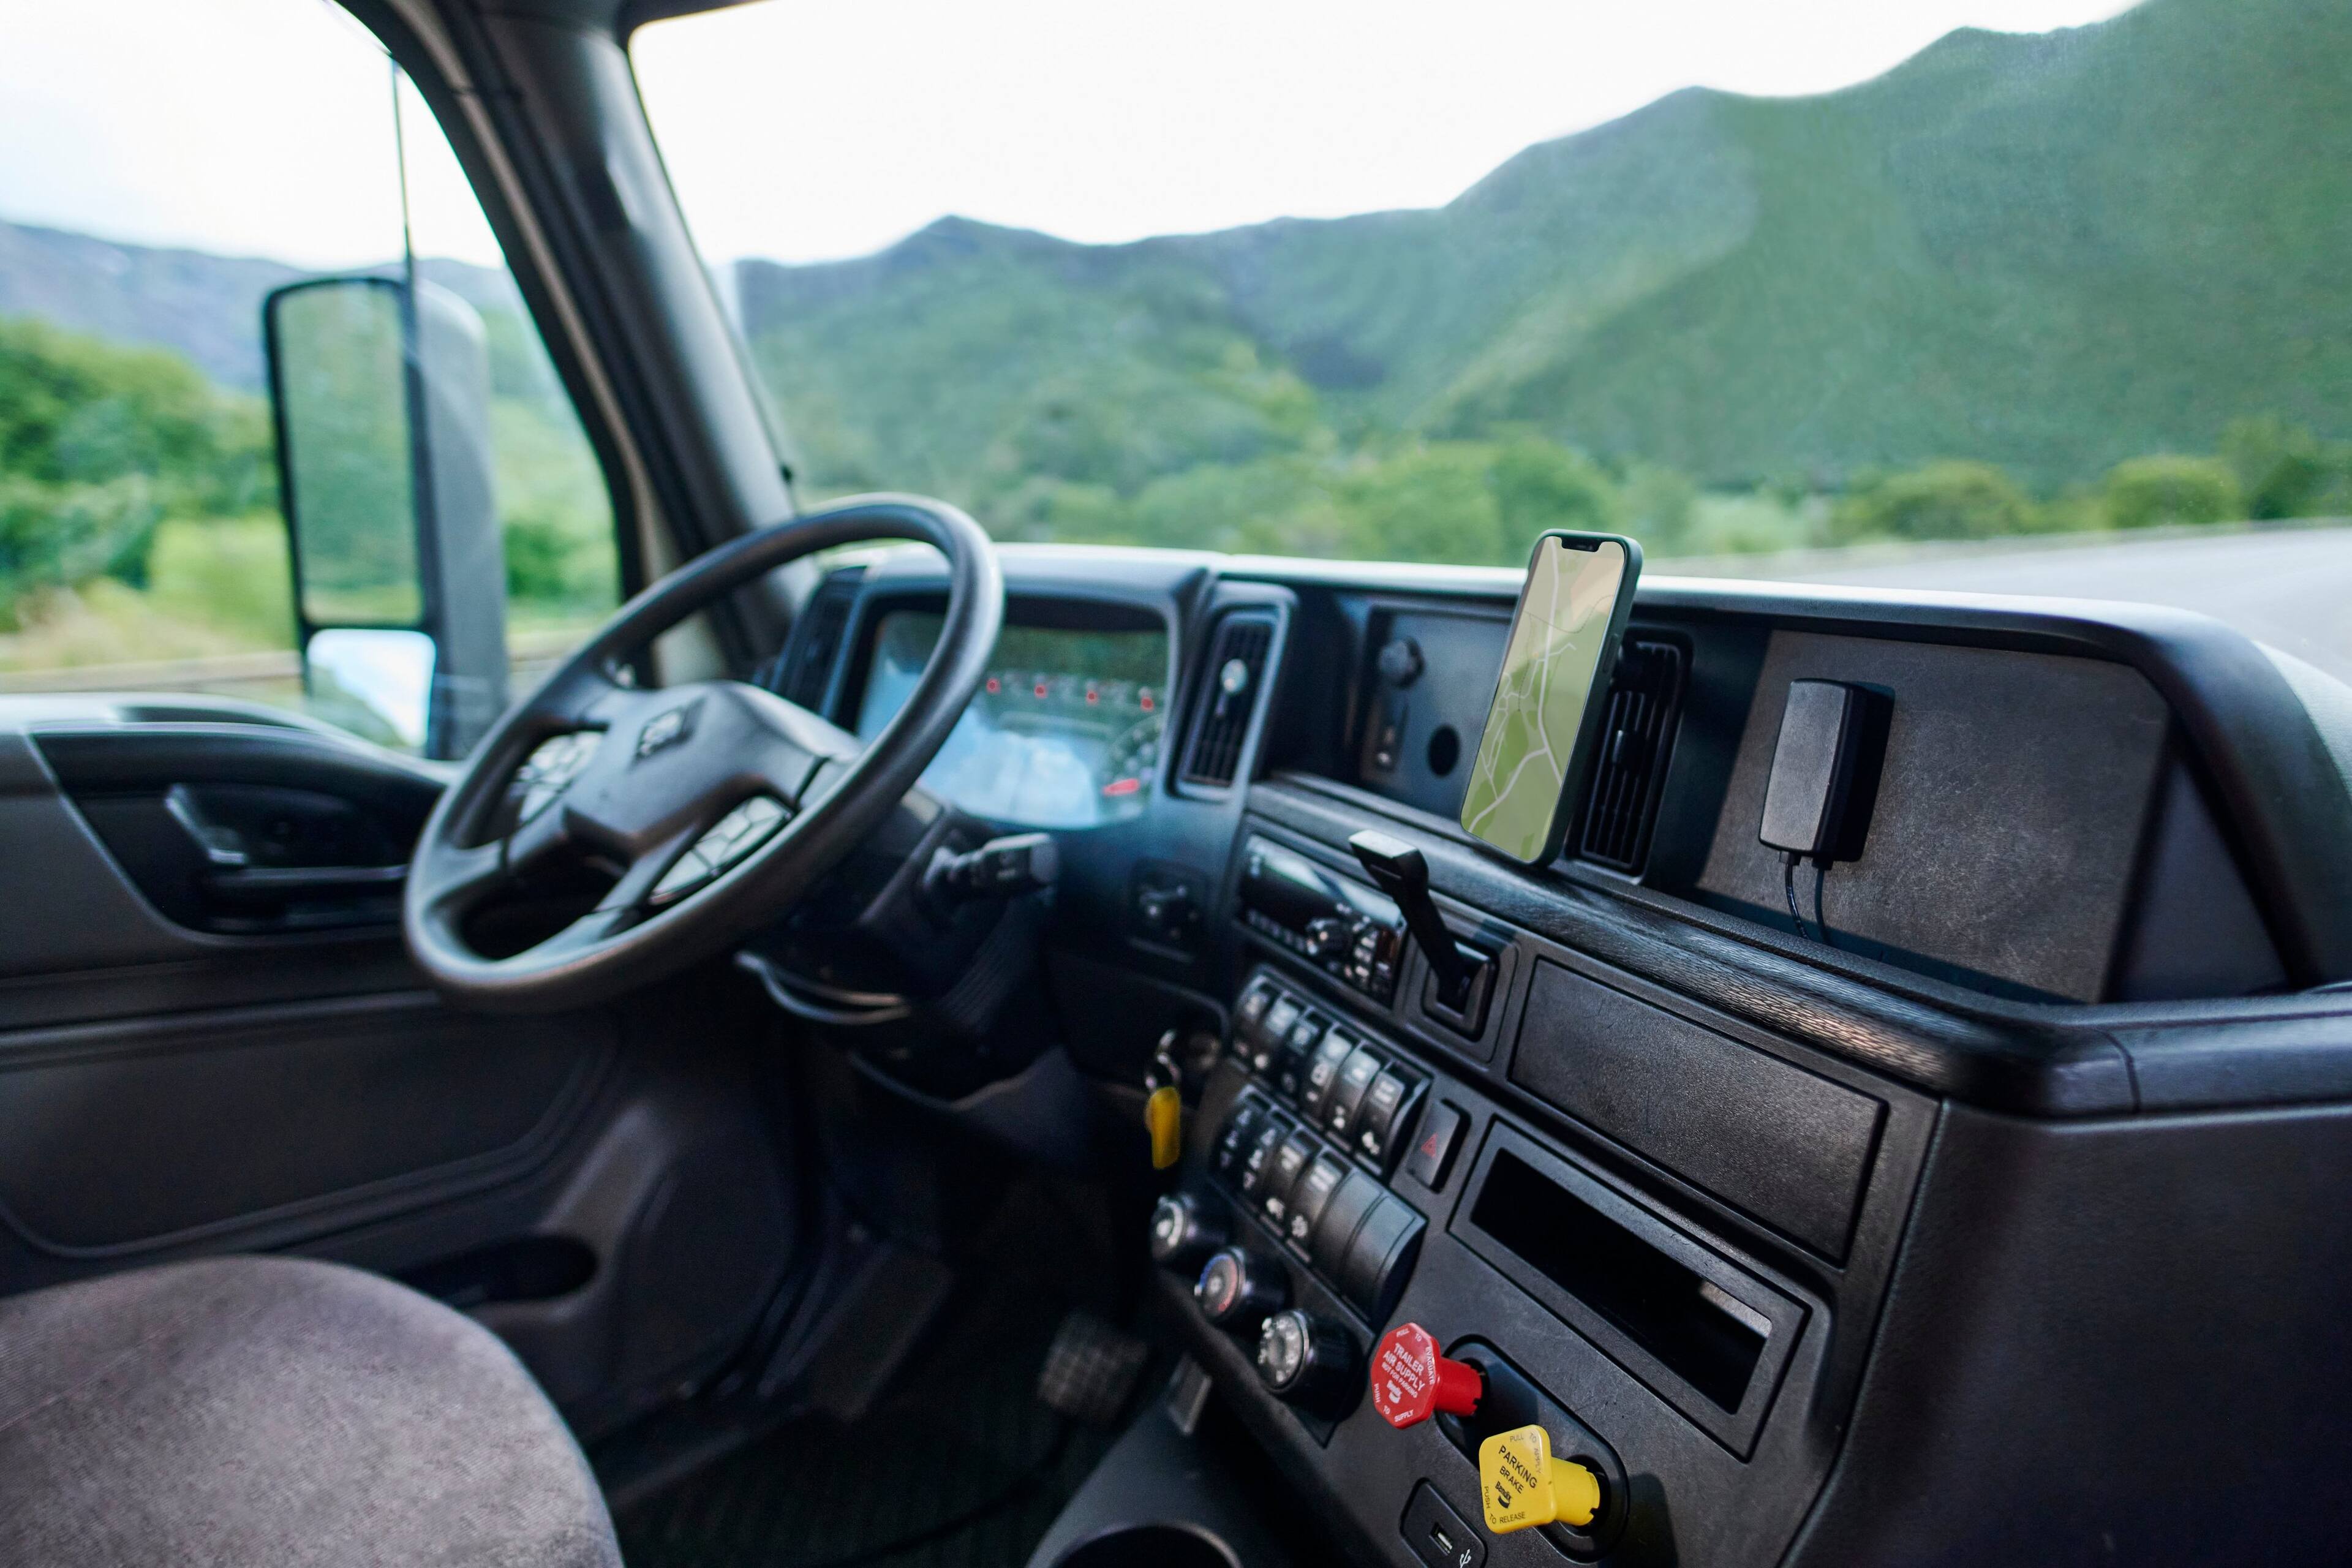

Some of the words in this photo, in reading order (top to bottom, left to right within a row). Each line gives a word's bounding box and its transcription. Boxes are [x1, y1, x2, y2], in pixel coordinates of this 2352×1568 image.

[1382, 1351, 1396, 1366] AIR
[1395, 1362, 1425, 1391] SUPPLY
[1393, 1343, 1424, 1376] TRAILER
[1415, 1333, 1422, 1342] TO
[1425, 1346, 1435, 1384] EVACUATE
[1381, 1362, 1390, 1373] NOT
[1390, 1369, 1400, 1382] FOR
[1398, 1378, 1418, 1398] PARKING
[1383, 1405, 1390, 1415] TO
[1394, 1409, 1414, 1422] SUPPLY
[1510, 1433, 1524, 1442] PULL
[1529, 1433, 1537, 1443] TO
[1498, 1445, 1537, 1488] PARKING
[1499, 1466, 1524, 1494] BRAKE
[1495, 1480, 1512, 1500] Bendix
[1490, 1513, 1496, 1525] TO
[1499, 1512, 1526, 1523] RELEASE
